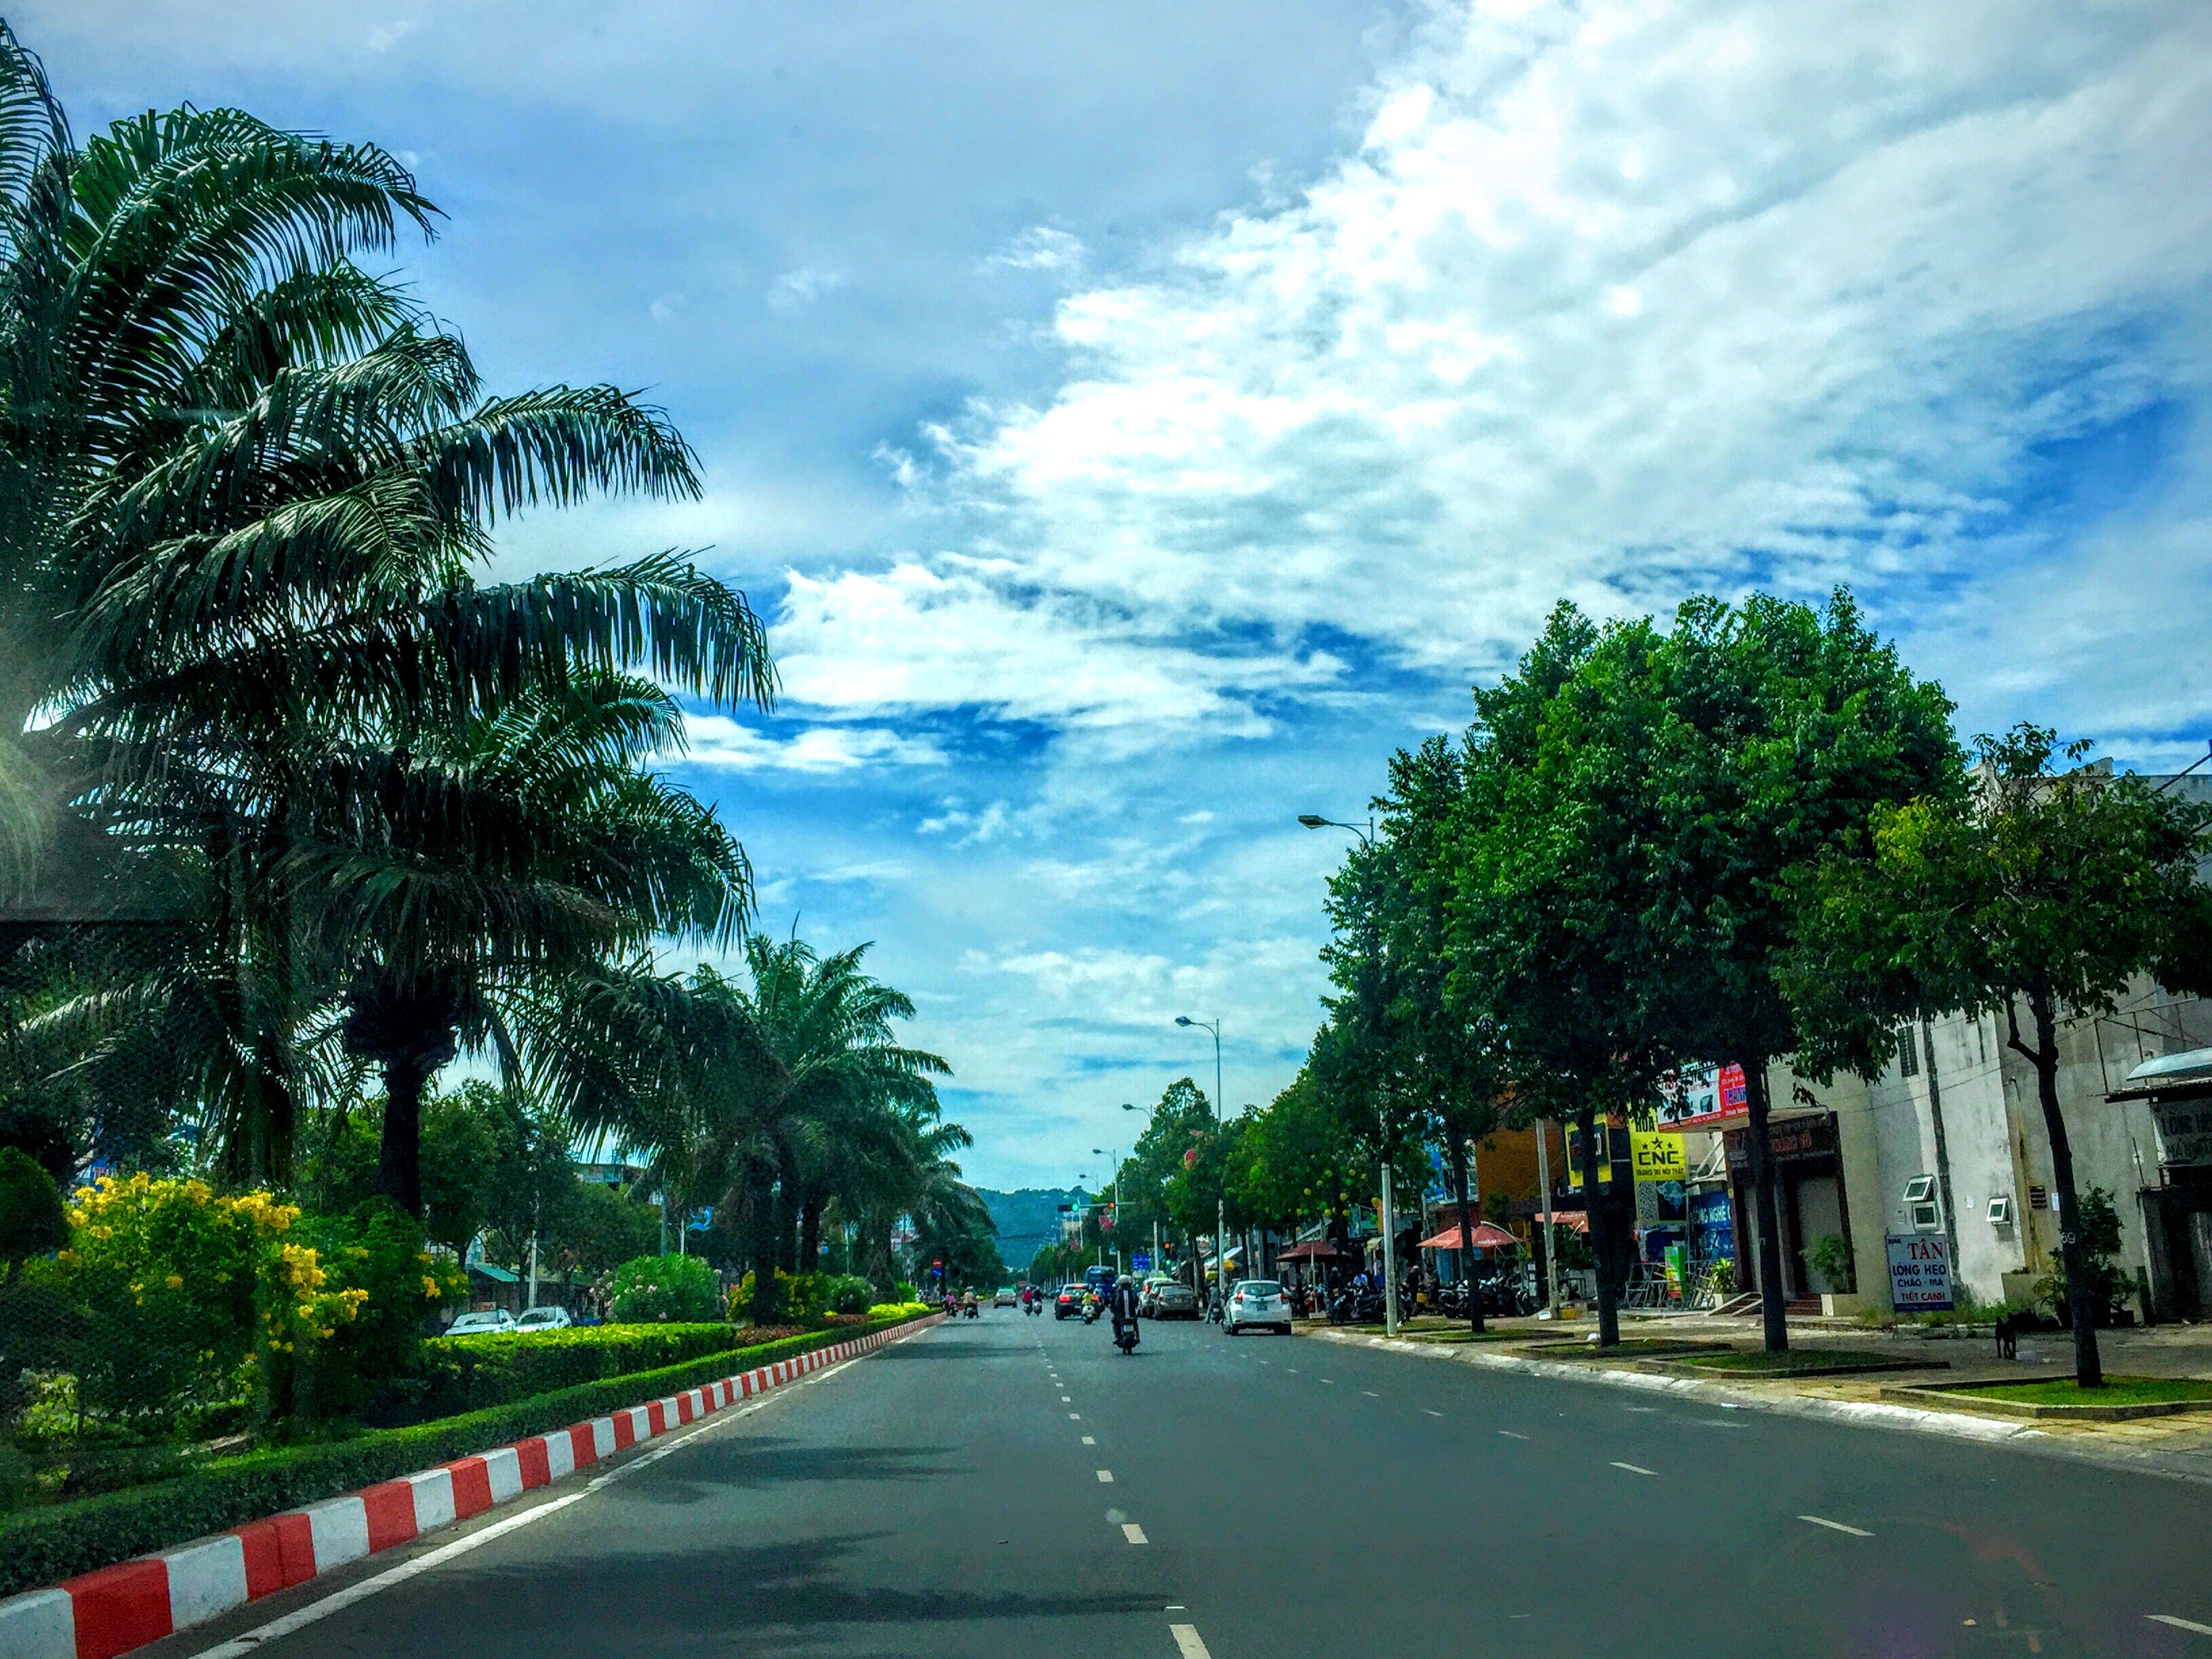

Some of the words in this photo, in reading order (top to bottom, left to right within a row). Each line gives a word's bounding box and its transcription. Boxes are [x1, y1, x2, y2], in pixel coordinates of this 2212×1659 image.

[1638, 1151, 1679, 1165] CNC
[1907, 1237, 1943, 1260] TÂN
[1925, 1264, 1946, 1275] HEO
